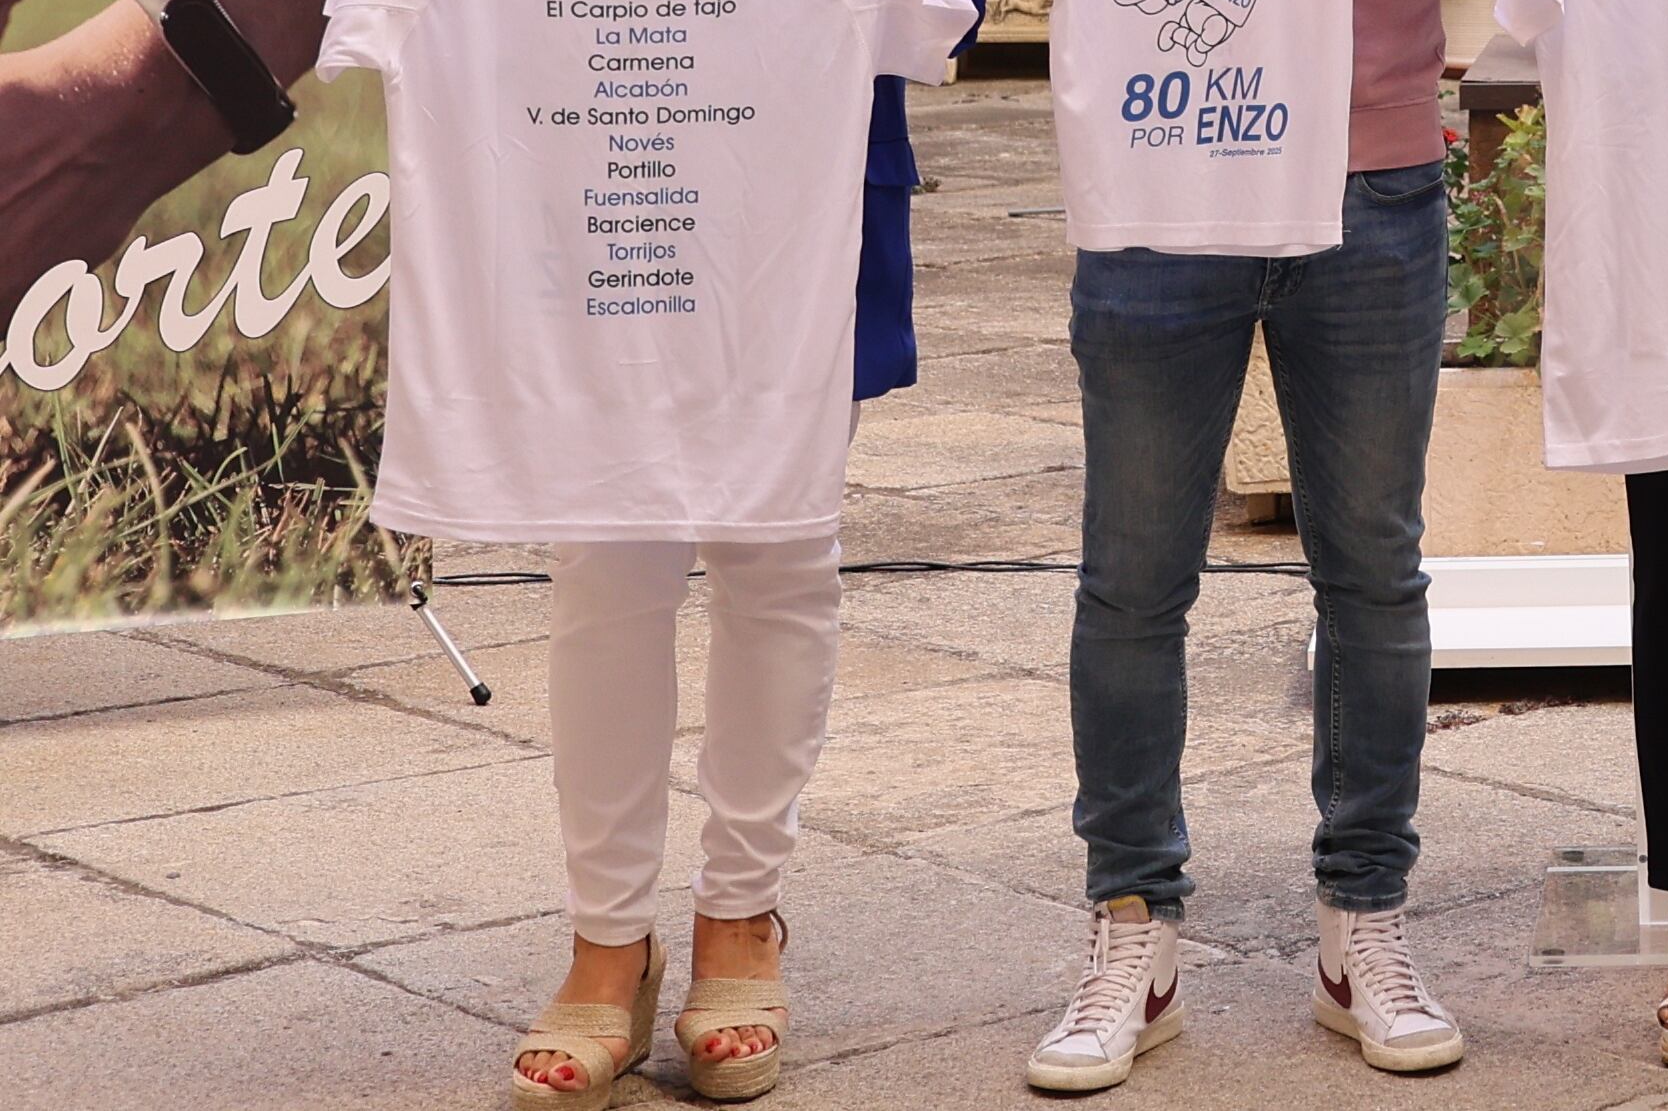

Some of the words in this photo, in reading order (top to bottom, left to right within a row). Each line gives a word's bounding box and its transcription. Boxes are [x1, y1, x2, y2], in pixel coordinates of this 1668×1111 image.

[547, 0, 563, 17] El
[571, 0, 648, 21] Carpio
[656, 1, 686, 17] de
[596, 28, 620, 45] La
[629, 27, 687, 44] Mata
[588, 54, 694, 71] Carmena
[594, 80, 688, 98] Alcabón
[1121, 70, 1190, 122] 80
[1205, 67, 1263, 101] KM
[527, 107, 543, 125] V.
[551, 108, 580, 125] de
[587, 108, 649, 125] Santo
[657, 105, 755, 125] Domingo
[1131, 126, 1184, 148] POR
[1196, 103, 1288, 145] ENZO
[609, 133, 674, 152] Novés
[608, 162, 676, 179] Portillo
[584, 188, 699, 206] Fuensalida
[587, 216, 695, 233] Barcience
[607, 242, 676, 263] Torrijos
[588, 270, 694, 288] Gerindote
[587, 296, 695, 315] Escalonilla
